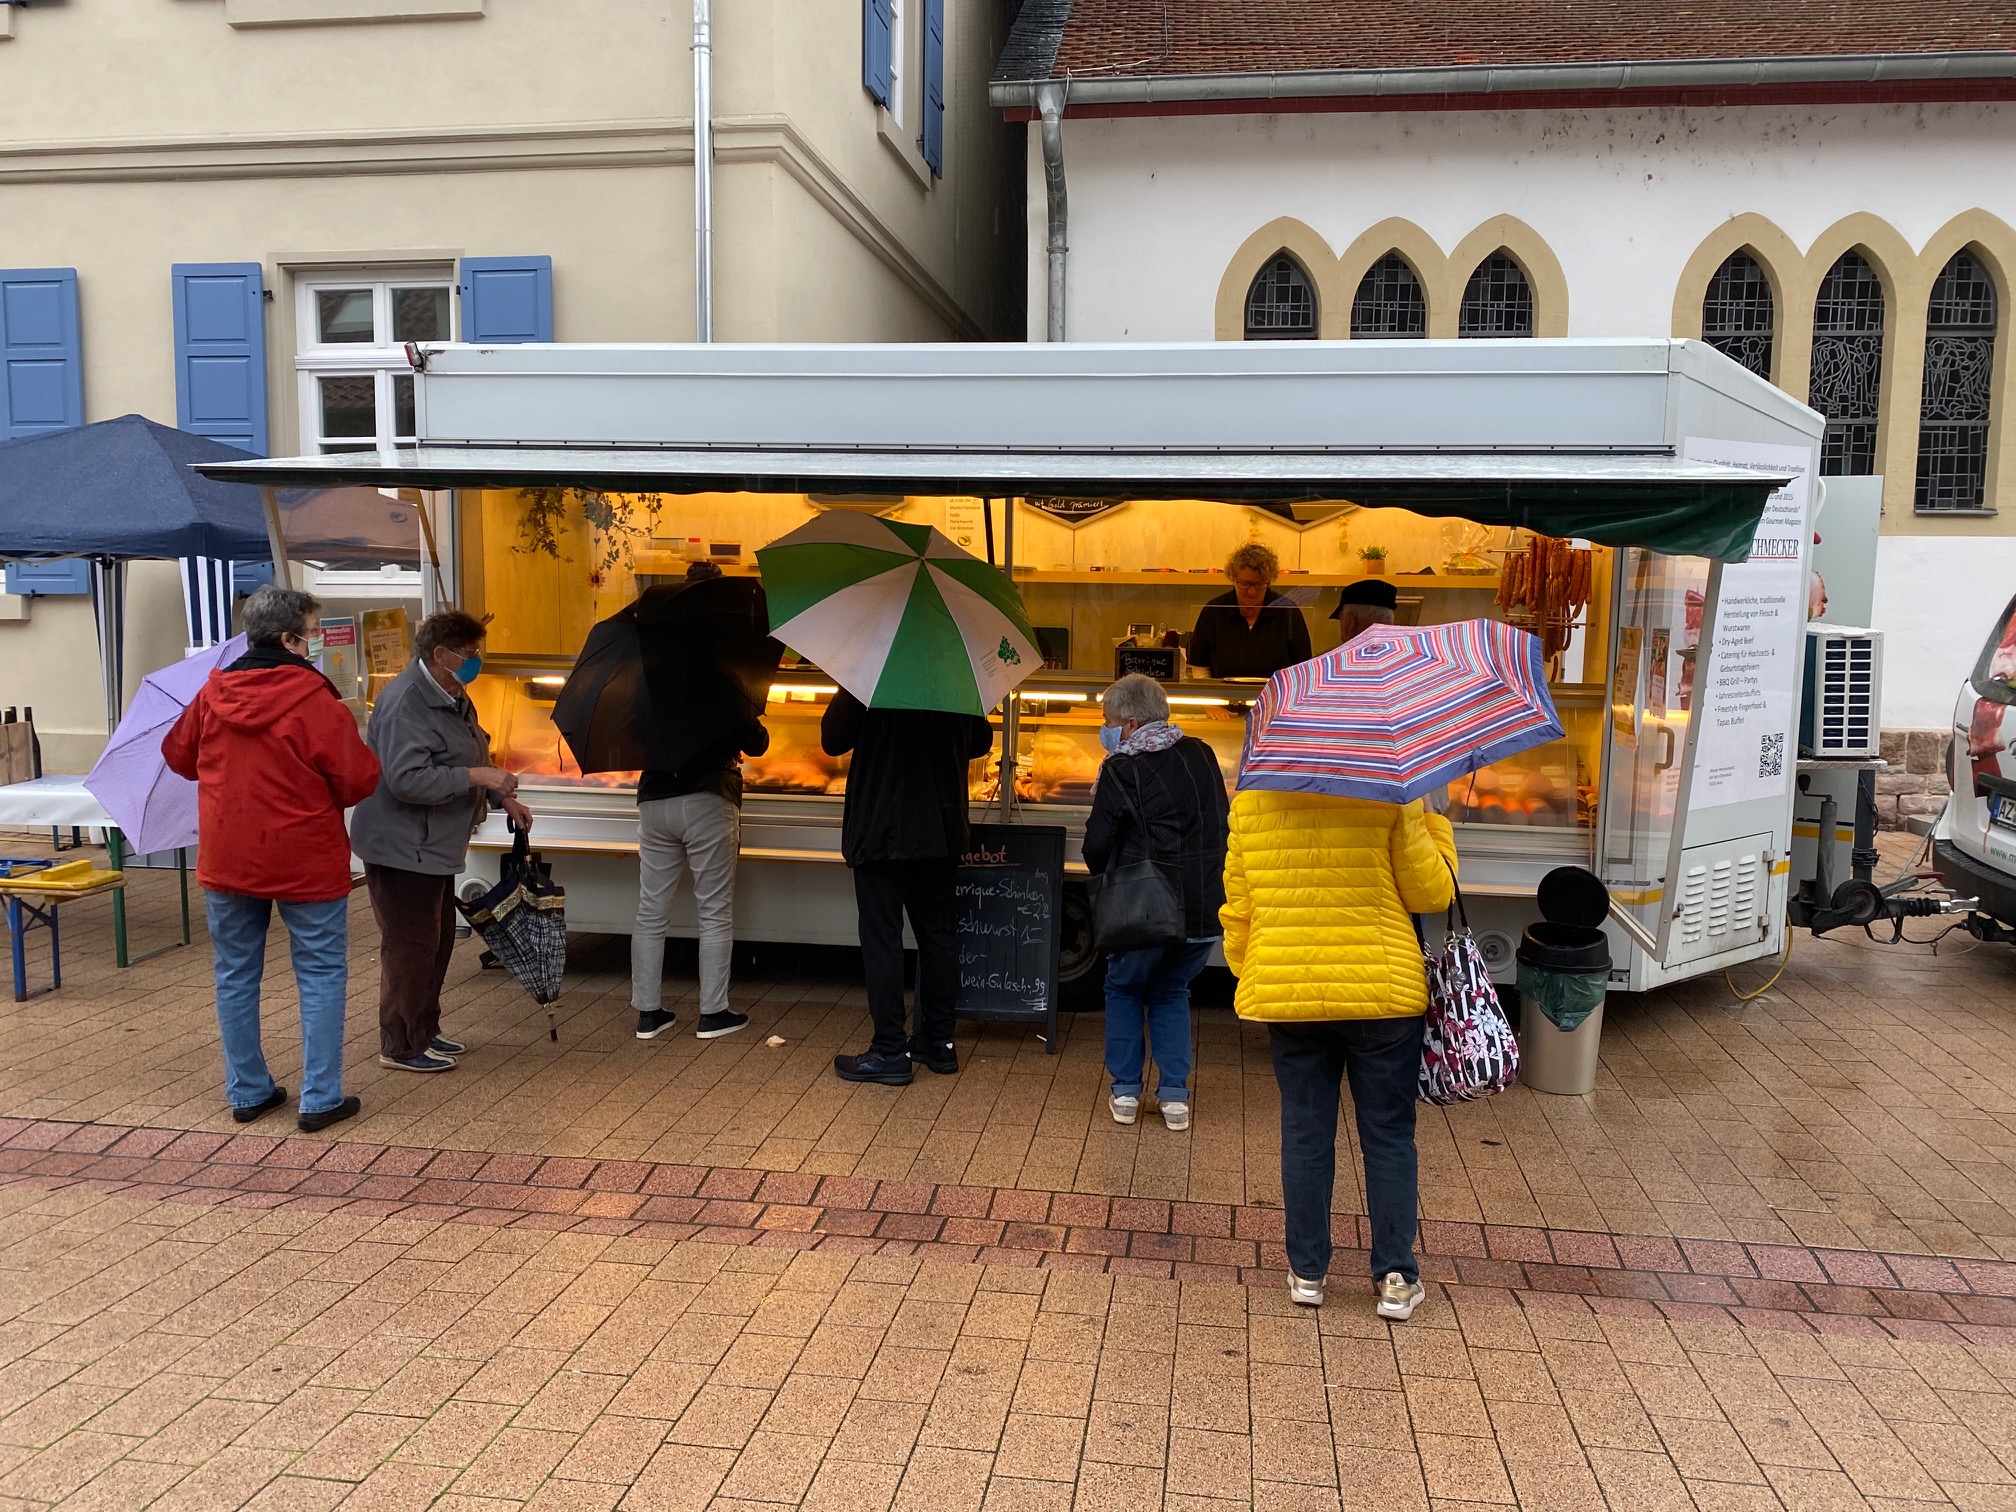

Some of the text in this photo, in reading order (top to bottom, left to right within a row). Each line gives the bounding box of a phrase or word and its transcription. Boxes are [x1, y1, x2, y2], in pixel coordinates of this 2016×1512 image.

[1749, 462, 1778, 472] Verlässlichkeit
[1779, 464, 1787, 472] und
[1787, 464, 1806, 473] Tradition
[1783, 493, 1794, 501] 2015
[1048, 498, 1066, 509] Gold
[1766, 517, 1801, 527] Gourmet-Magazin
[1750, 538, 1799, 557] CHMECKER
[1725, 595, 1786, 605] Handwerkliche, traditionelle
[1723, 609, 1749, 619] Herstellung
[1759, 609, 1774, 617] Fleisch
[1774, 608, 1778, 617] &
[1722, 624, 1751, 632] Wurstwaren
[1721, 636, 1755, 647] Dry-Aged Beef
[1121, 653, 1168, 666] Barrique
[1720, 651, 1740, 660] Catering
[1748, 649, 1770, 657] Hochzeits-
[1771, 648, 1775, 656] &
[1719, 663, 1760, 673] Geburtstagsfeiern
[1719, 678, 1730, 687] BBQ
[1730, 677, 1740, 686] Grill
[1744, 676, 1758, 685] Partys
[1718, 688, 1761, 700] Jahreszeitenbuffets
[1717, 701, 1767, 713] Freestyle Fingerfood &
[1716, 716, 1745, 728] Tapas Buffet
[1999, 800, 2014, 820] AZ
[957, 909, 1018, 937] schwurst
